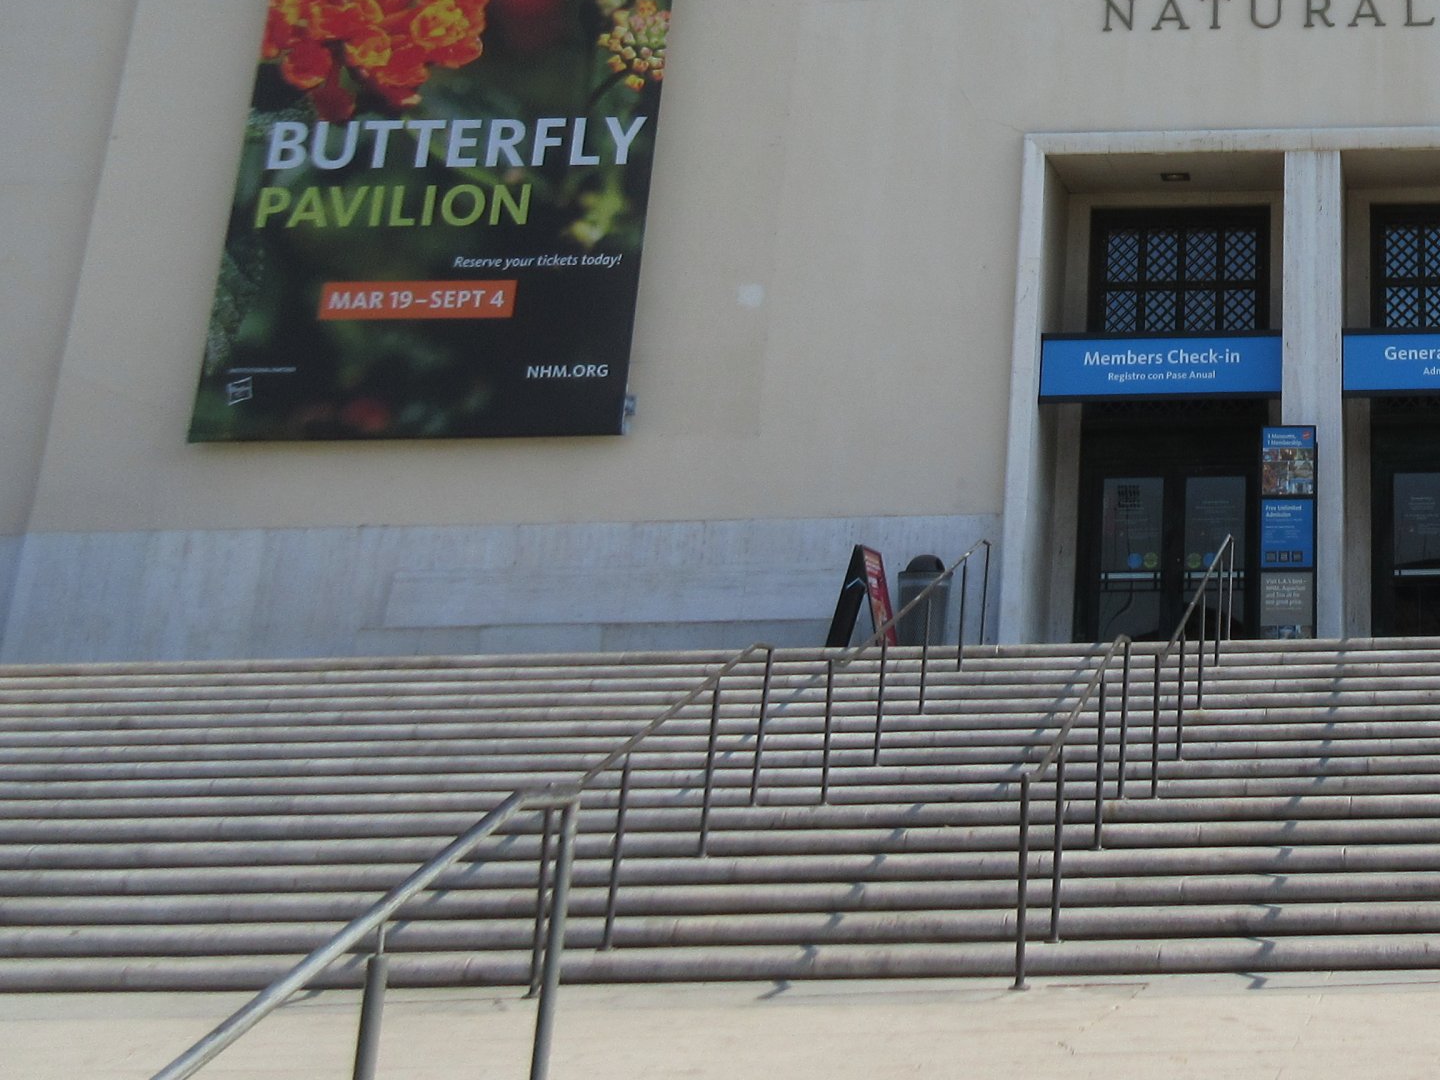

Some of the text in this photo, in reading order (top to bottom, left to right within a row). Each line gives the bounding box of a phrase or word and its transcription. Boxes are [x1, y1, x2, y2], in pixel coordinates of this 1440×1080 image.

[265, 115, 648, 171] BUTTERFLY
[254, 183, 532, 229] PAVILION
[453, 253, 623, 270] Reserve your tickets today!
[329, 291, 383, 310] MAR
[490, 290, 505, 308] 4
[1083, 348, 1240, 366] Members Check-in
[526, 364, 609, 379] NHM.ORG
[1108, 370, 1216, 383] Registro con Pase Anual
